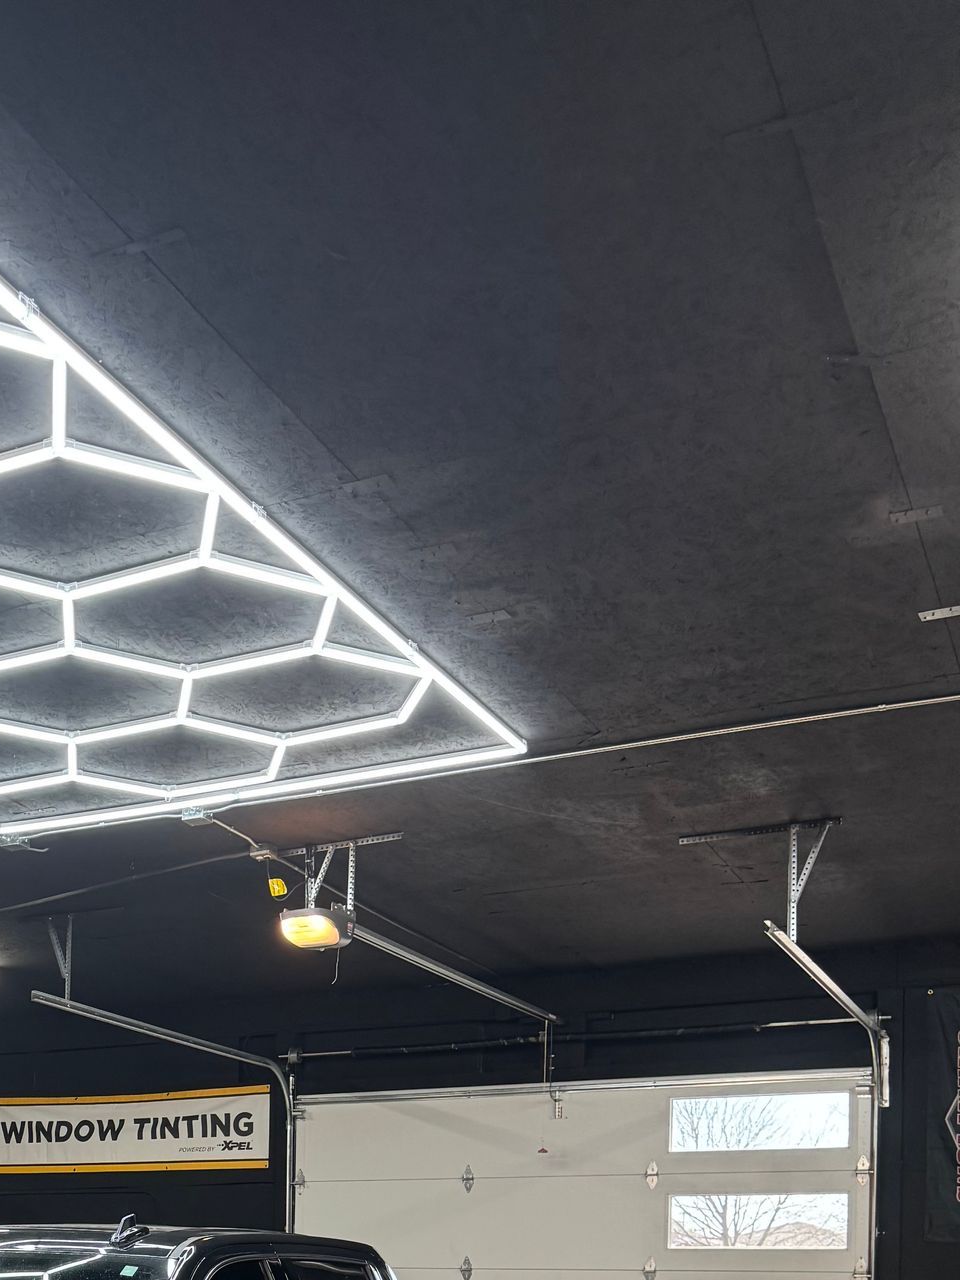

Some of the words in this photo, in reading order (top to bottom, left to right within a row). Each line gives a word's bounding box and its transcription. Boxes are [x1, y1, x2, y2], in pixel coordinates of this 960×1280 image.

[0, 1119, 125, 1144] WINDOW
[133, 1112, 254, 1140] TINTING
[220, 1140, 253, 1151] XPEL
